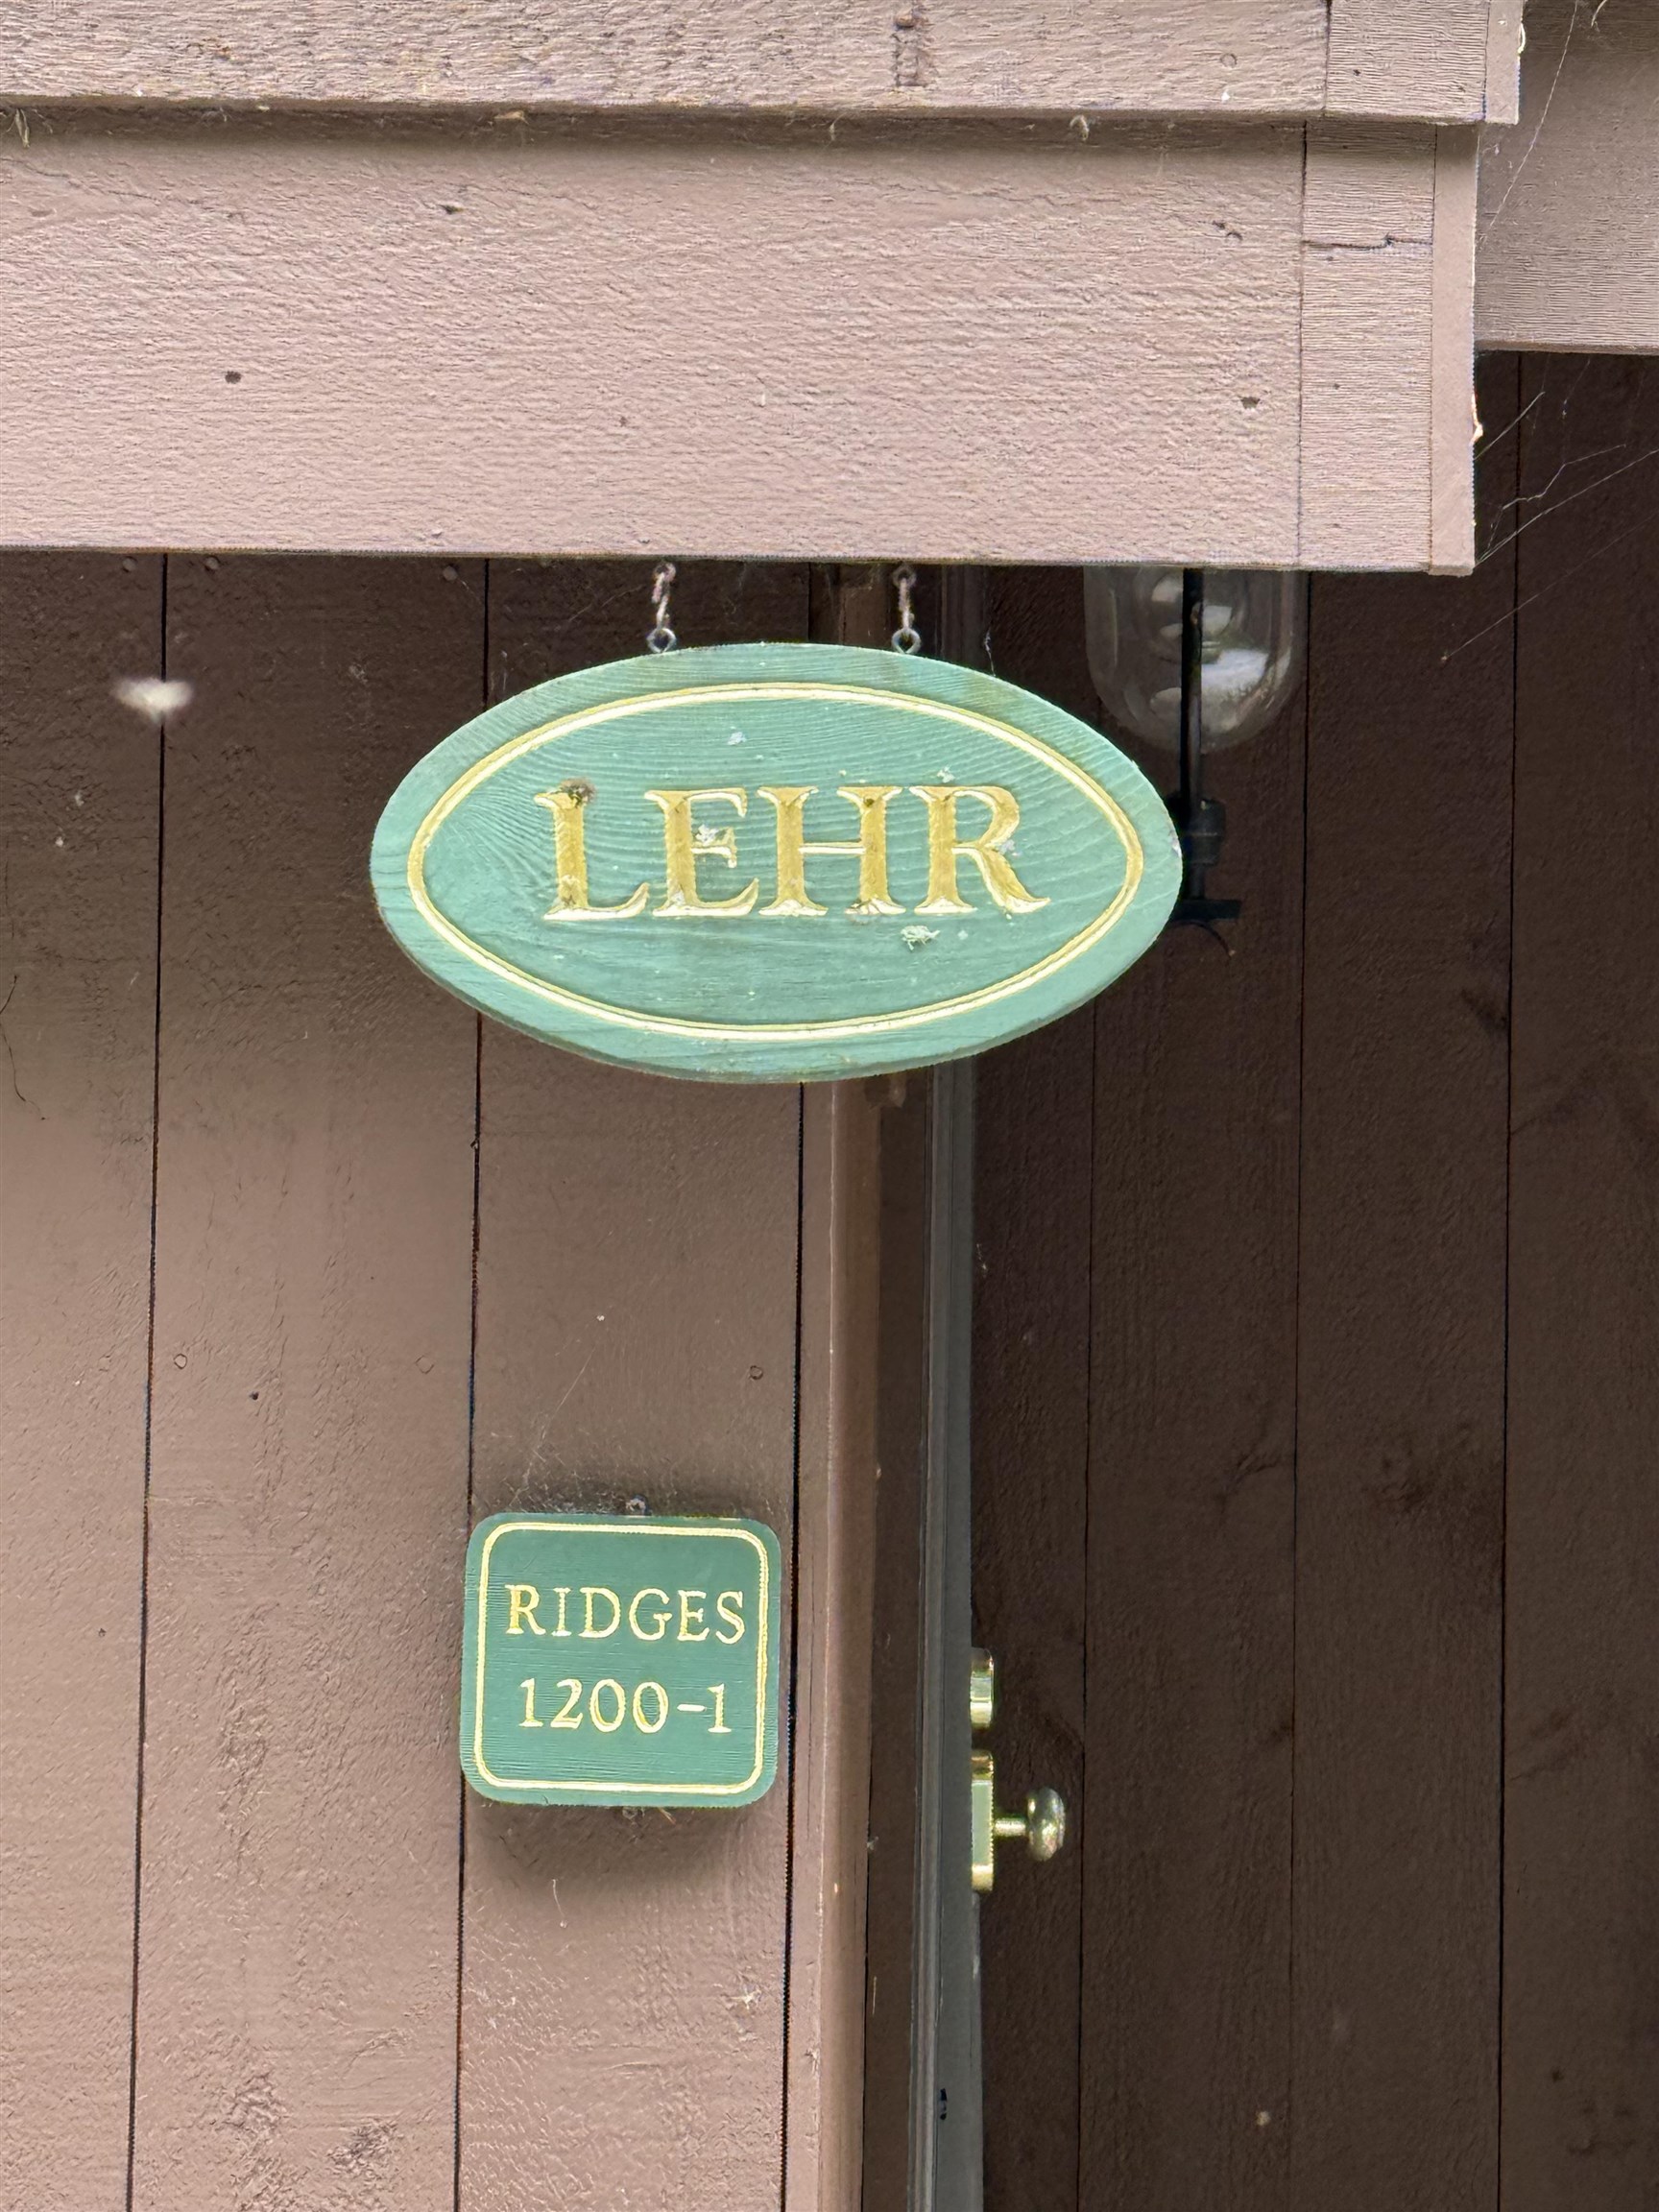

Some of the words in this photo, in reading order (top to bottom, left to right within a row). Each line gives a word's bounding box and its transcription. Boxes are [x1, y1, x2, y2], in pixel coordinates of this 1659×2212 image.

[534, 785, 1051, 922] LEHR
[504, 1584, 746, 1645] RIDGES
[517, 1677, 733, 1734] 1200-1
